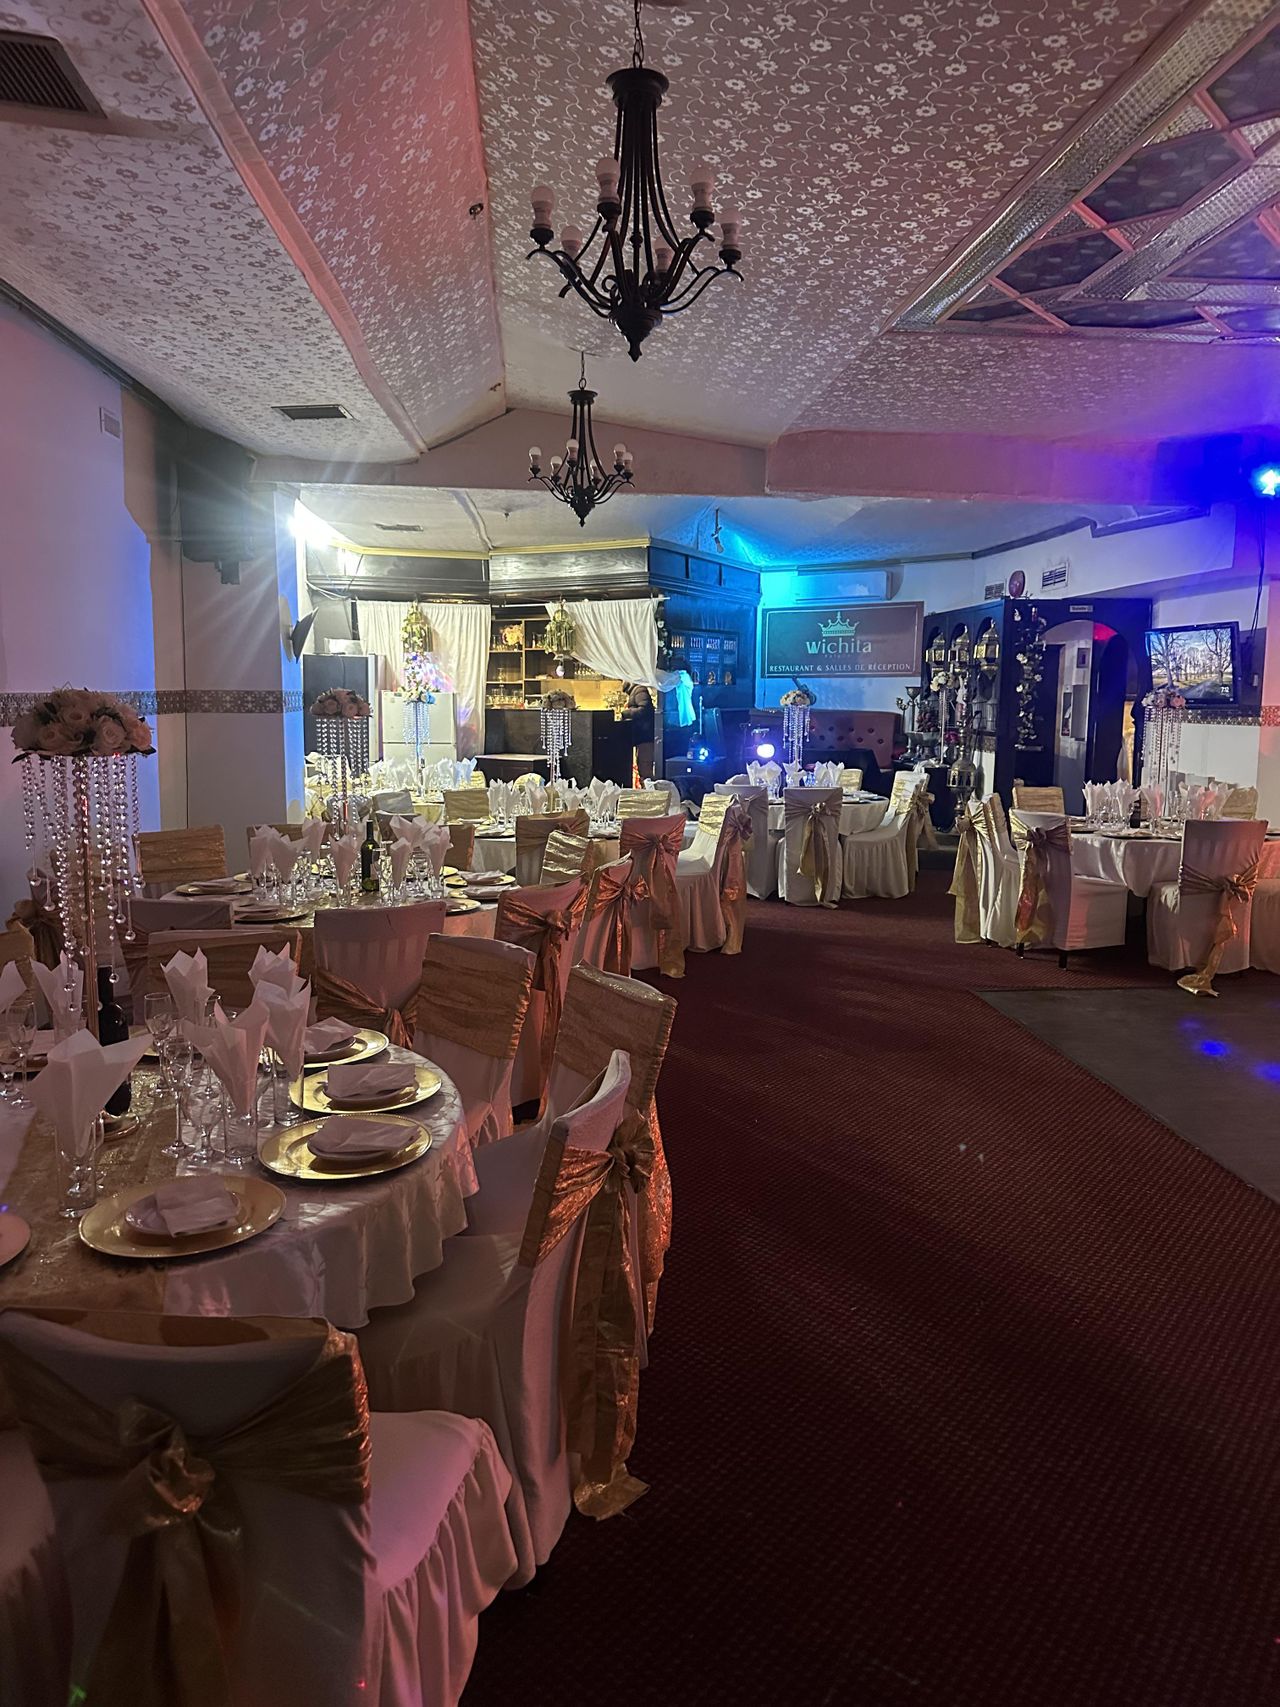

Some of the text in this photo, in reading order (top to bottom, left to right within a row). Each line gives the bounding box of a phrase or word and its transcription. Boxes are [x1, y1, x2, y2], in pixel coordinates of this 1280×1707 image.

[769, 662, 911, 672] RESTAURANT & SALLES DE RÉCEPTION
